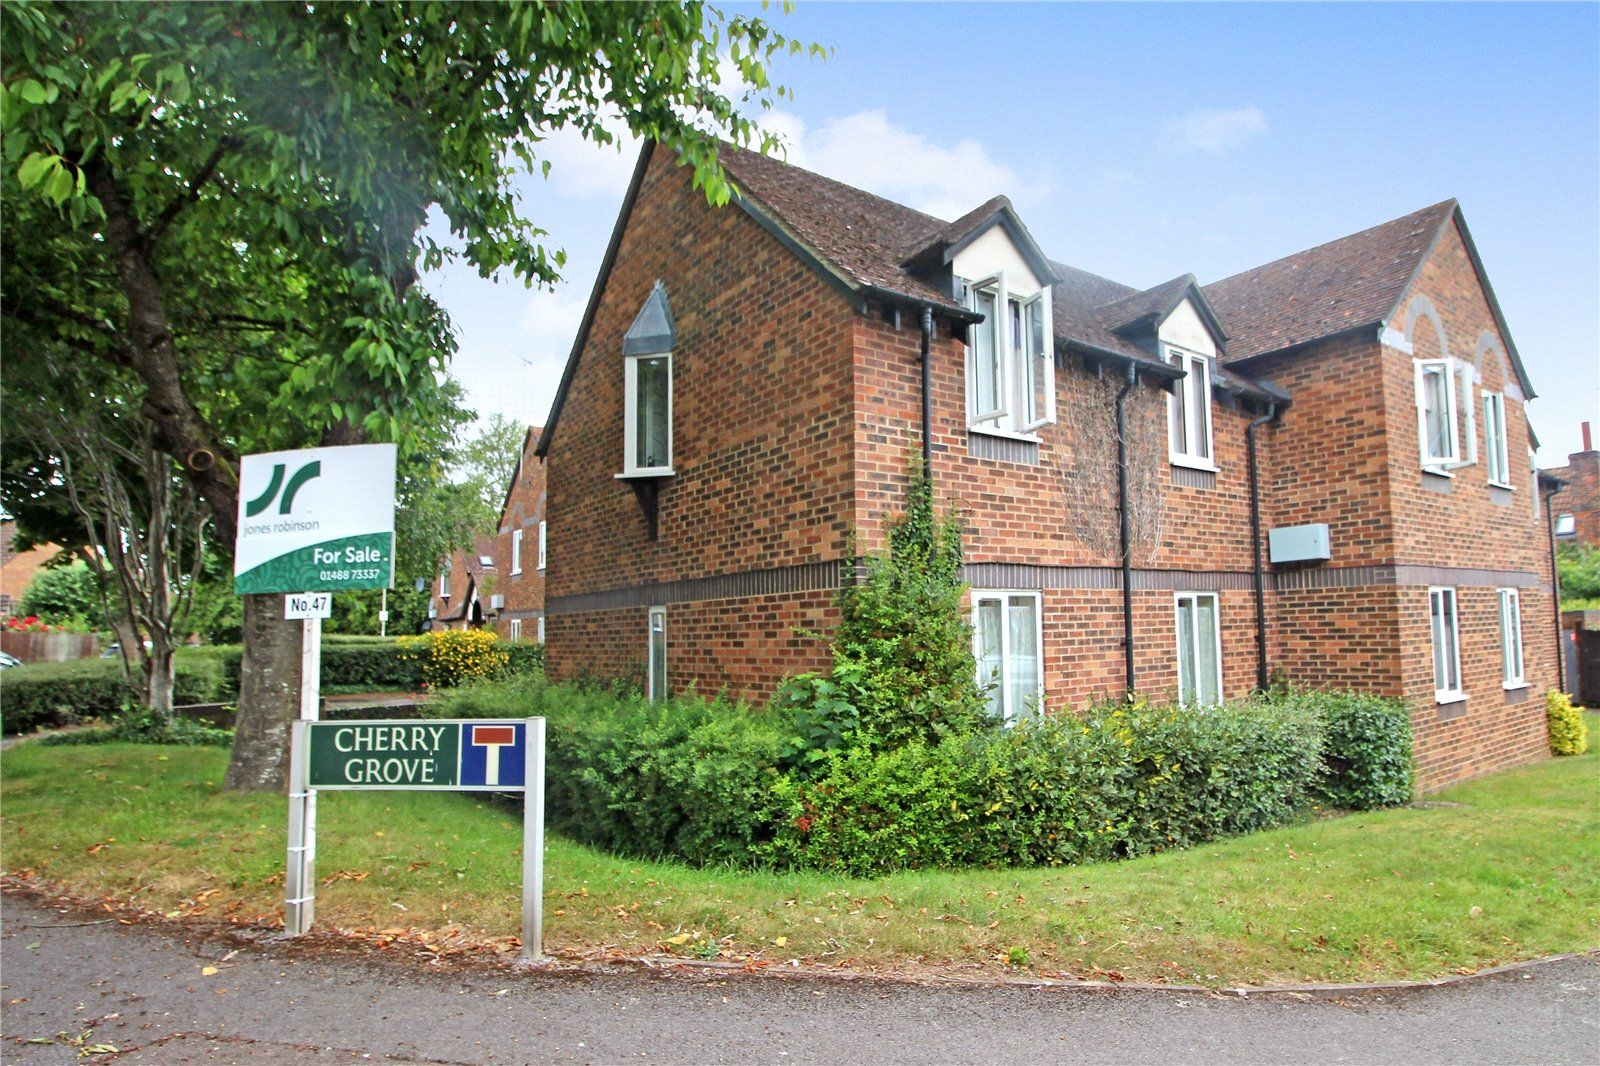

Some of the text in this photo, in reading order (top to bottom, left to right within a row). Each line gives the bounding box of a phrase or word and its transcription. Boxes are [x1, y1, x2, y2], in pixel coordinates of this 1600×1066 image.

[243, 520, 320, 538] jones robinson
[313, 547, 342, 565] For
[320, 569, 380, 581] 01488 73337
[334, 726, 446, 753] CHERRY
[344, 758, 435, 784] GROVE
